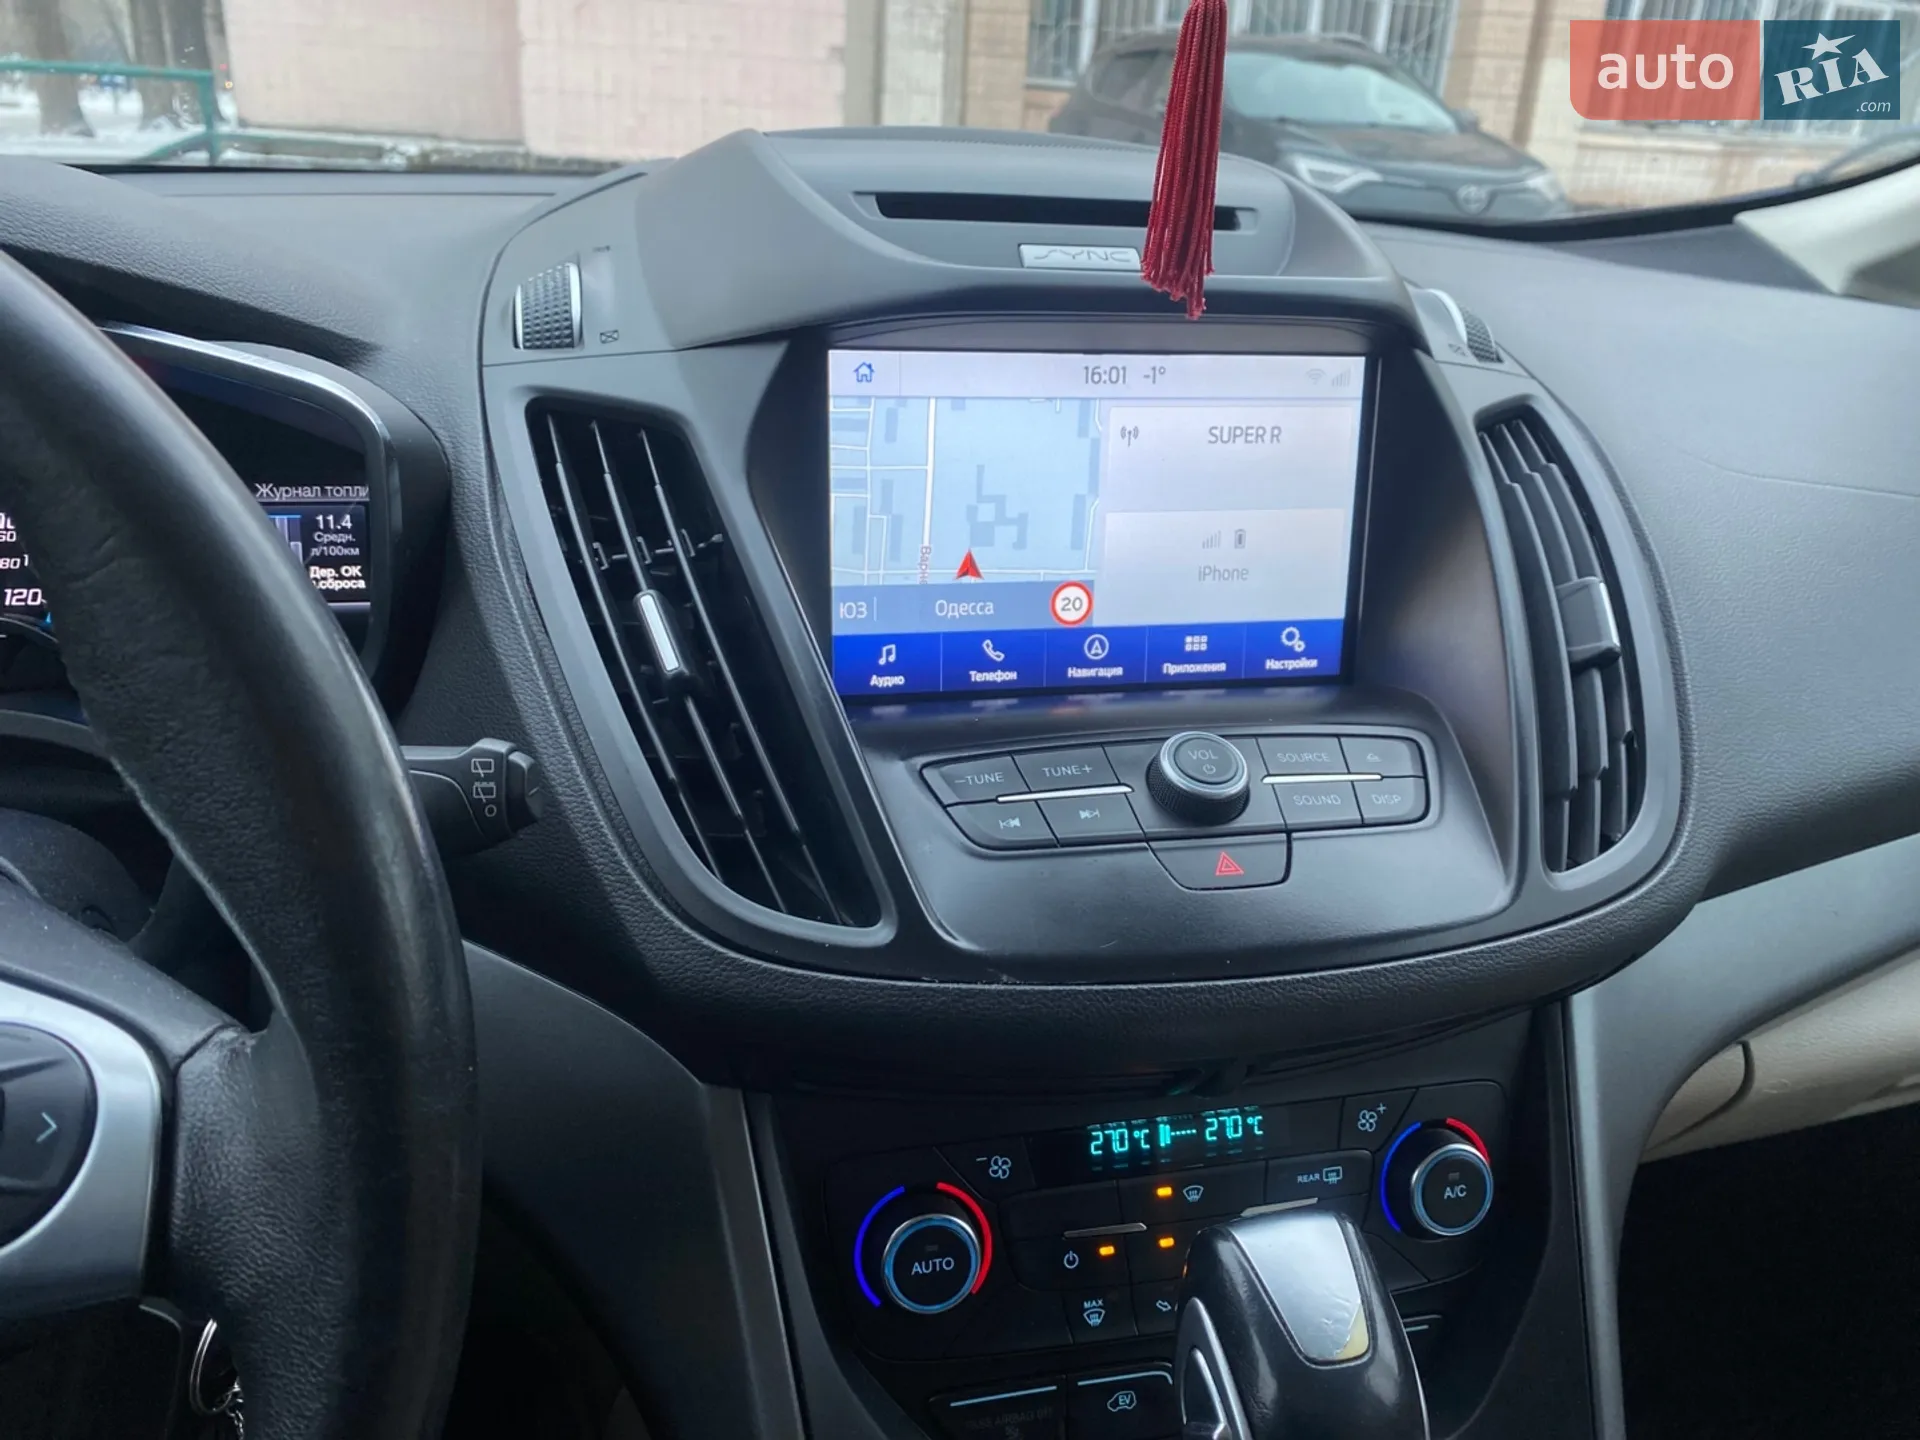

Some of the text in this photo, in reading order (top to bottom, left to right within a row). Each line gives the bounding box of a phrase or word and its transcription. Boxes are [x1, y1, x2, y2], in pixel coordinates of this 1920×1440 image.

[1034, 248, 1132, 263] SYNC
[1083, 365, 1167, 385] 16:01 -1°
[1207, 425, 1282, 445] SUPER R
[254, 483, 321, 501] Журнал
[315, 514, 353, 530] 11.4
[1198, 564, 1249, 582] iPhone
[4, 588, 42, 606] 120
[1060, 596, 1083, 612] 20
[935, 600, 995, 618] Одесса
[1162, 660, 1227, 676] Приложения
[1265, 656, 1319, 671] Настройки
[969, 669, 1017, 683] Телефон
[1067, 665, 1124, 679] Навигация
[870, 673, 905, 688] Аудио
[1188, 749, 1219, 761] VOL
[1276, 752, 1331, 763] SOURCE
[1293, 793, 1342, 806] SOUND
[1372, 793, 1402, 805] DISP
[1297, 1173, 1320, 1183] REAR
[1443, 1184, 1467, 1200] A/C
[911, 1257, 955, 1276] AUTO
[1083, 1299, 1104, 1309] MAX
[1118, 1394, 1132, 1405] EV
